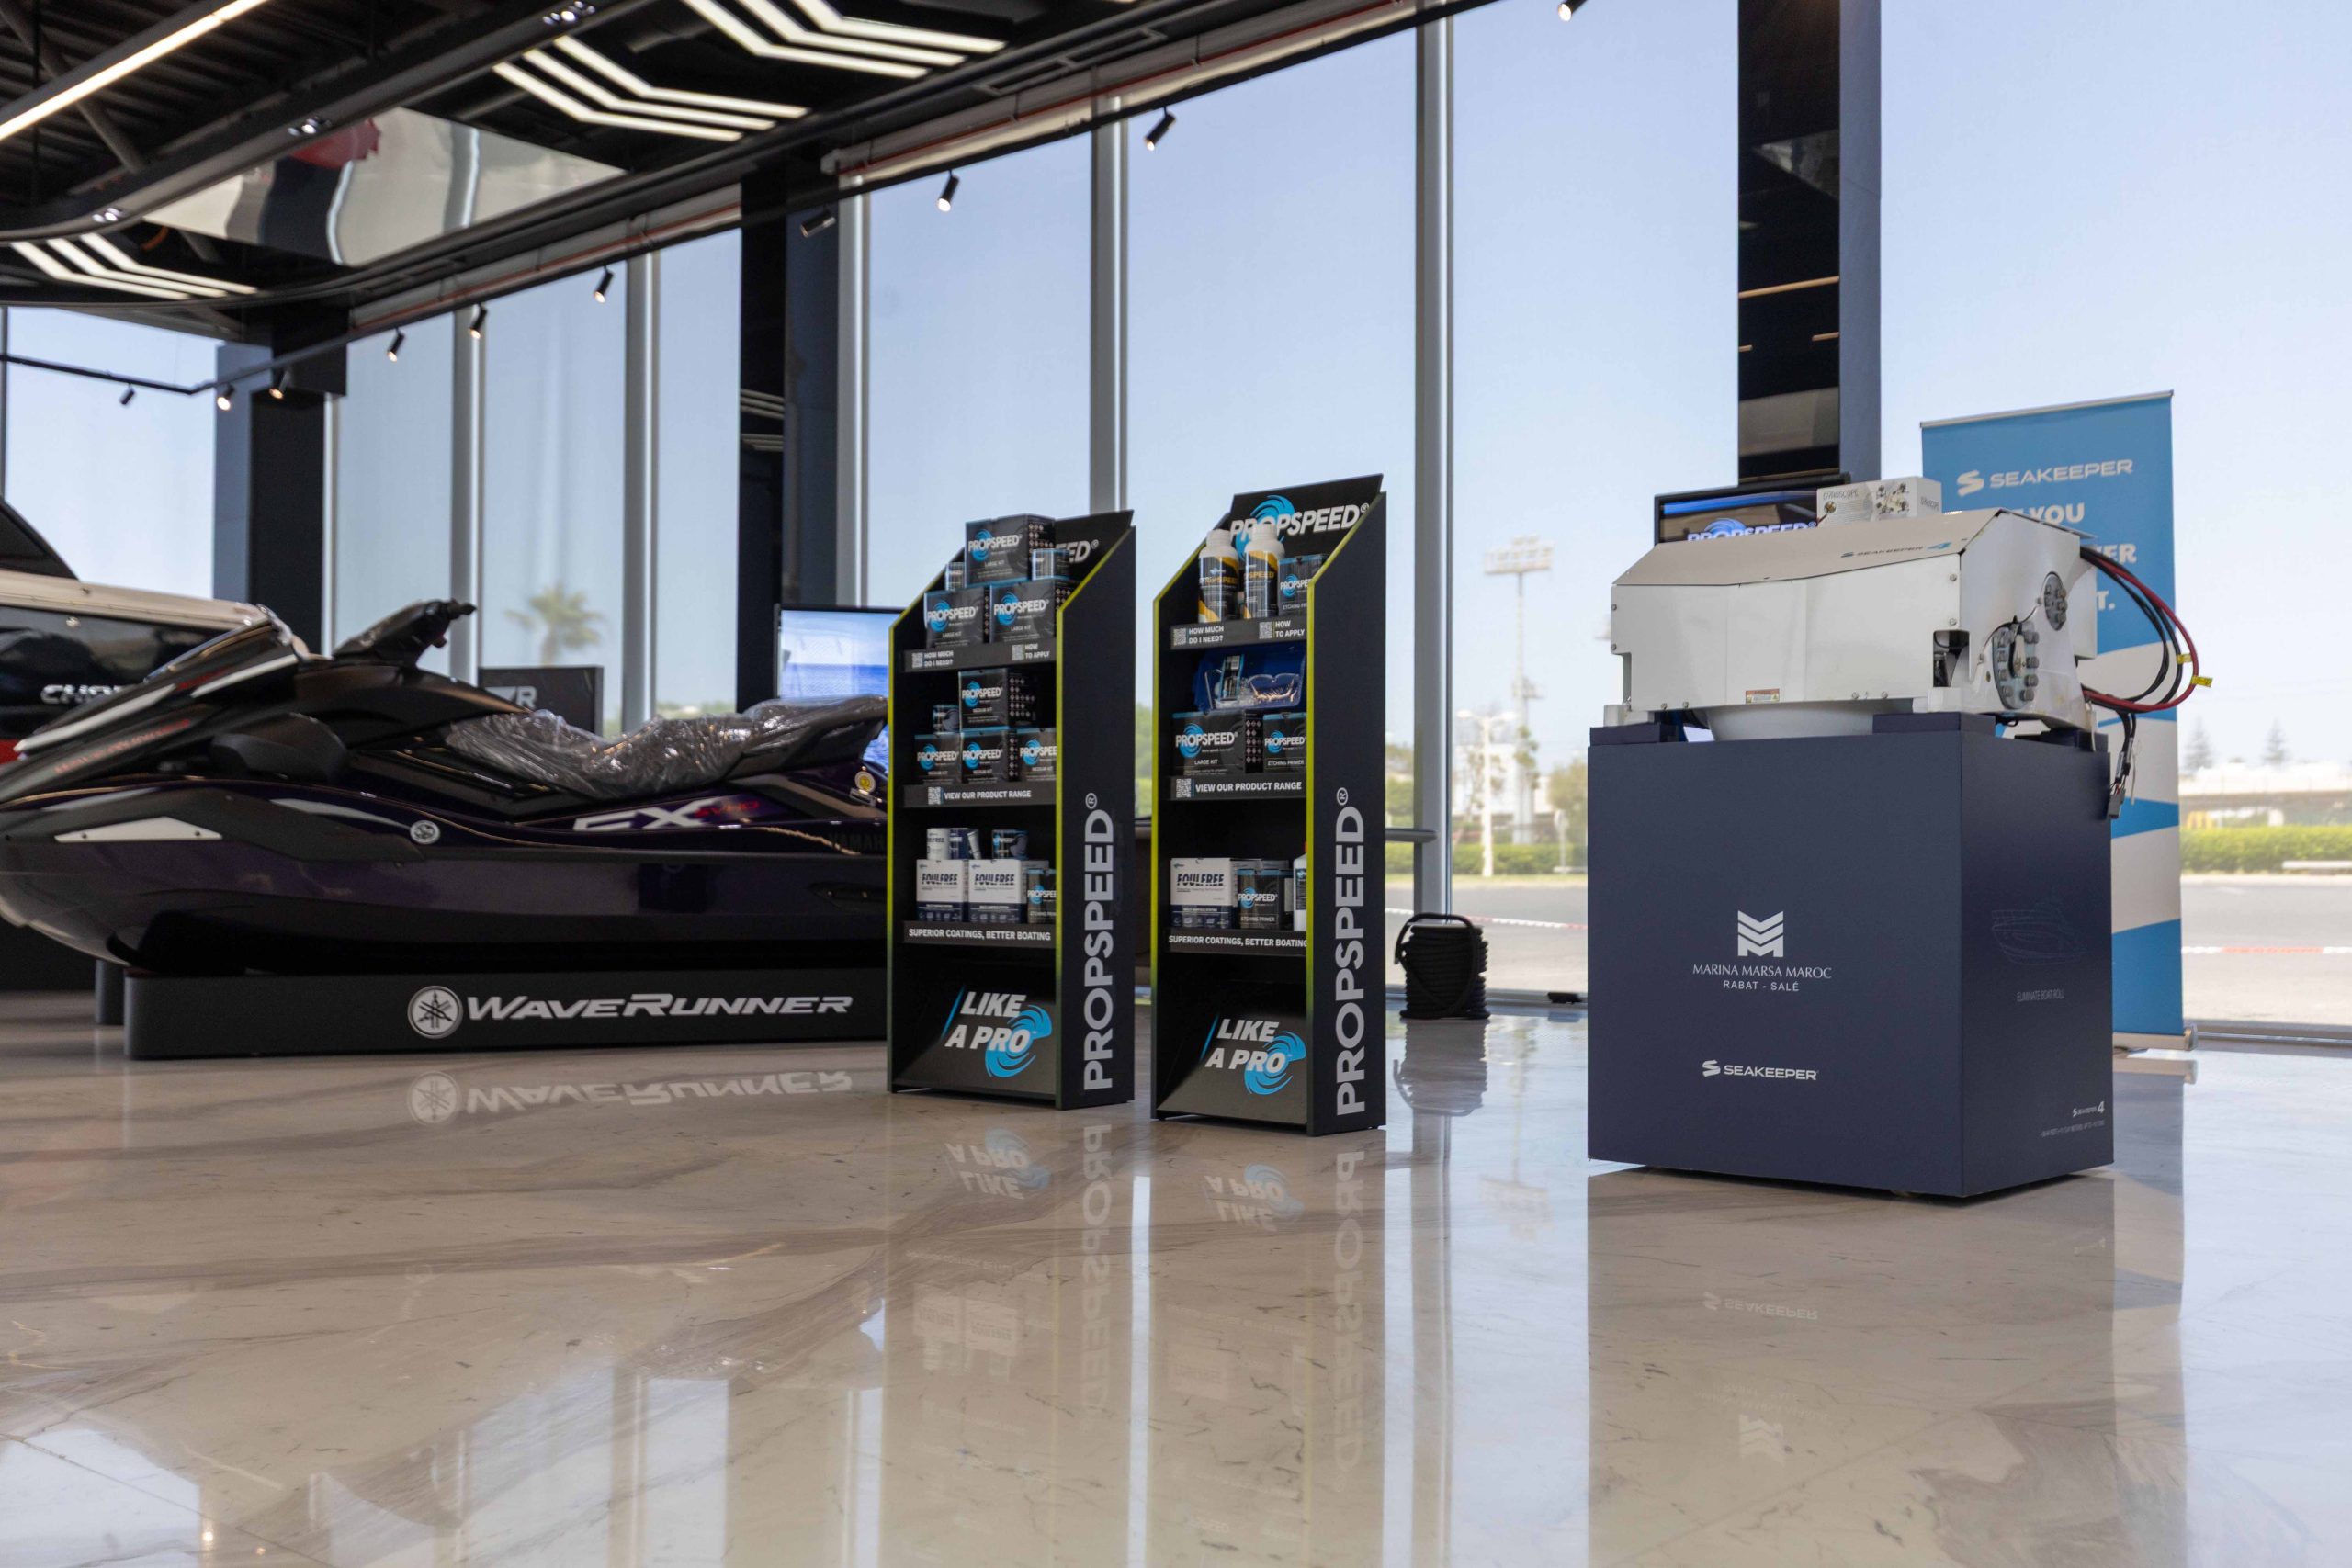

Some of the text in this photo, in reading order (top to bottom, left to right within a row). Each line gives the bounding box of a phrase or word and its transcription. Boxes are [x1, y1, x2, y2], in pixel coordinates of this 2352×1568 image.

[1990, 459, 2133, 489] SEAKEEPER
[994, 599, 1046, 616] PROPSPEED
[927, 606, 977, 623] PROPSPEED
[1205, 626, 1224, 634] MUCH
[1275, 620, 1291, 628] HOW
[1275, 628, 1305, 637] TO APPLY
[1203, 635, 1224, 643] NEED?
[962, 687, 1001, 699] PROPSPEED
[1175, 731, 1235, 747] PROPSPEED
[1264, 736, 1306, 746] PROPSPEED
[917, 751, 957, 761] PROPSPEED
[963, 749, 1001, 761] PROPSPEED
[1020, 746, 1057, 757] PROPSPEE
[1195, 782, 1302, 792] VIEW OUR PRODUCT RANGE
[909, 928, 1051, 941] SUPERIOR COATINGS, BETTER BOATING
[1169, 935, 1204, 944] SUPERIOR
[1205, 936, 1243, 946] COATINGS,
[1245, 938, 1273, 946] BETTER
[1692, 964, 1832, 979] MARINA MARSA MAROC
[1723, 980, 1758, 990] RABAT
[1770, 981, 1799, 992] SALÉ
[960, 991, 1026, 1018] LIKE
[1216, 1019, 1280, 1043] LIKE
[944, 1024, 1031, 1053] A PRO
[1204, 1048, 1287, 1073] A PRO
[1724, 1065, 1817, 1081] SEAKEEPER
